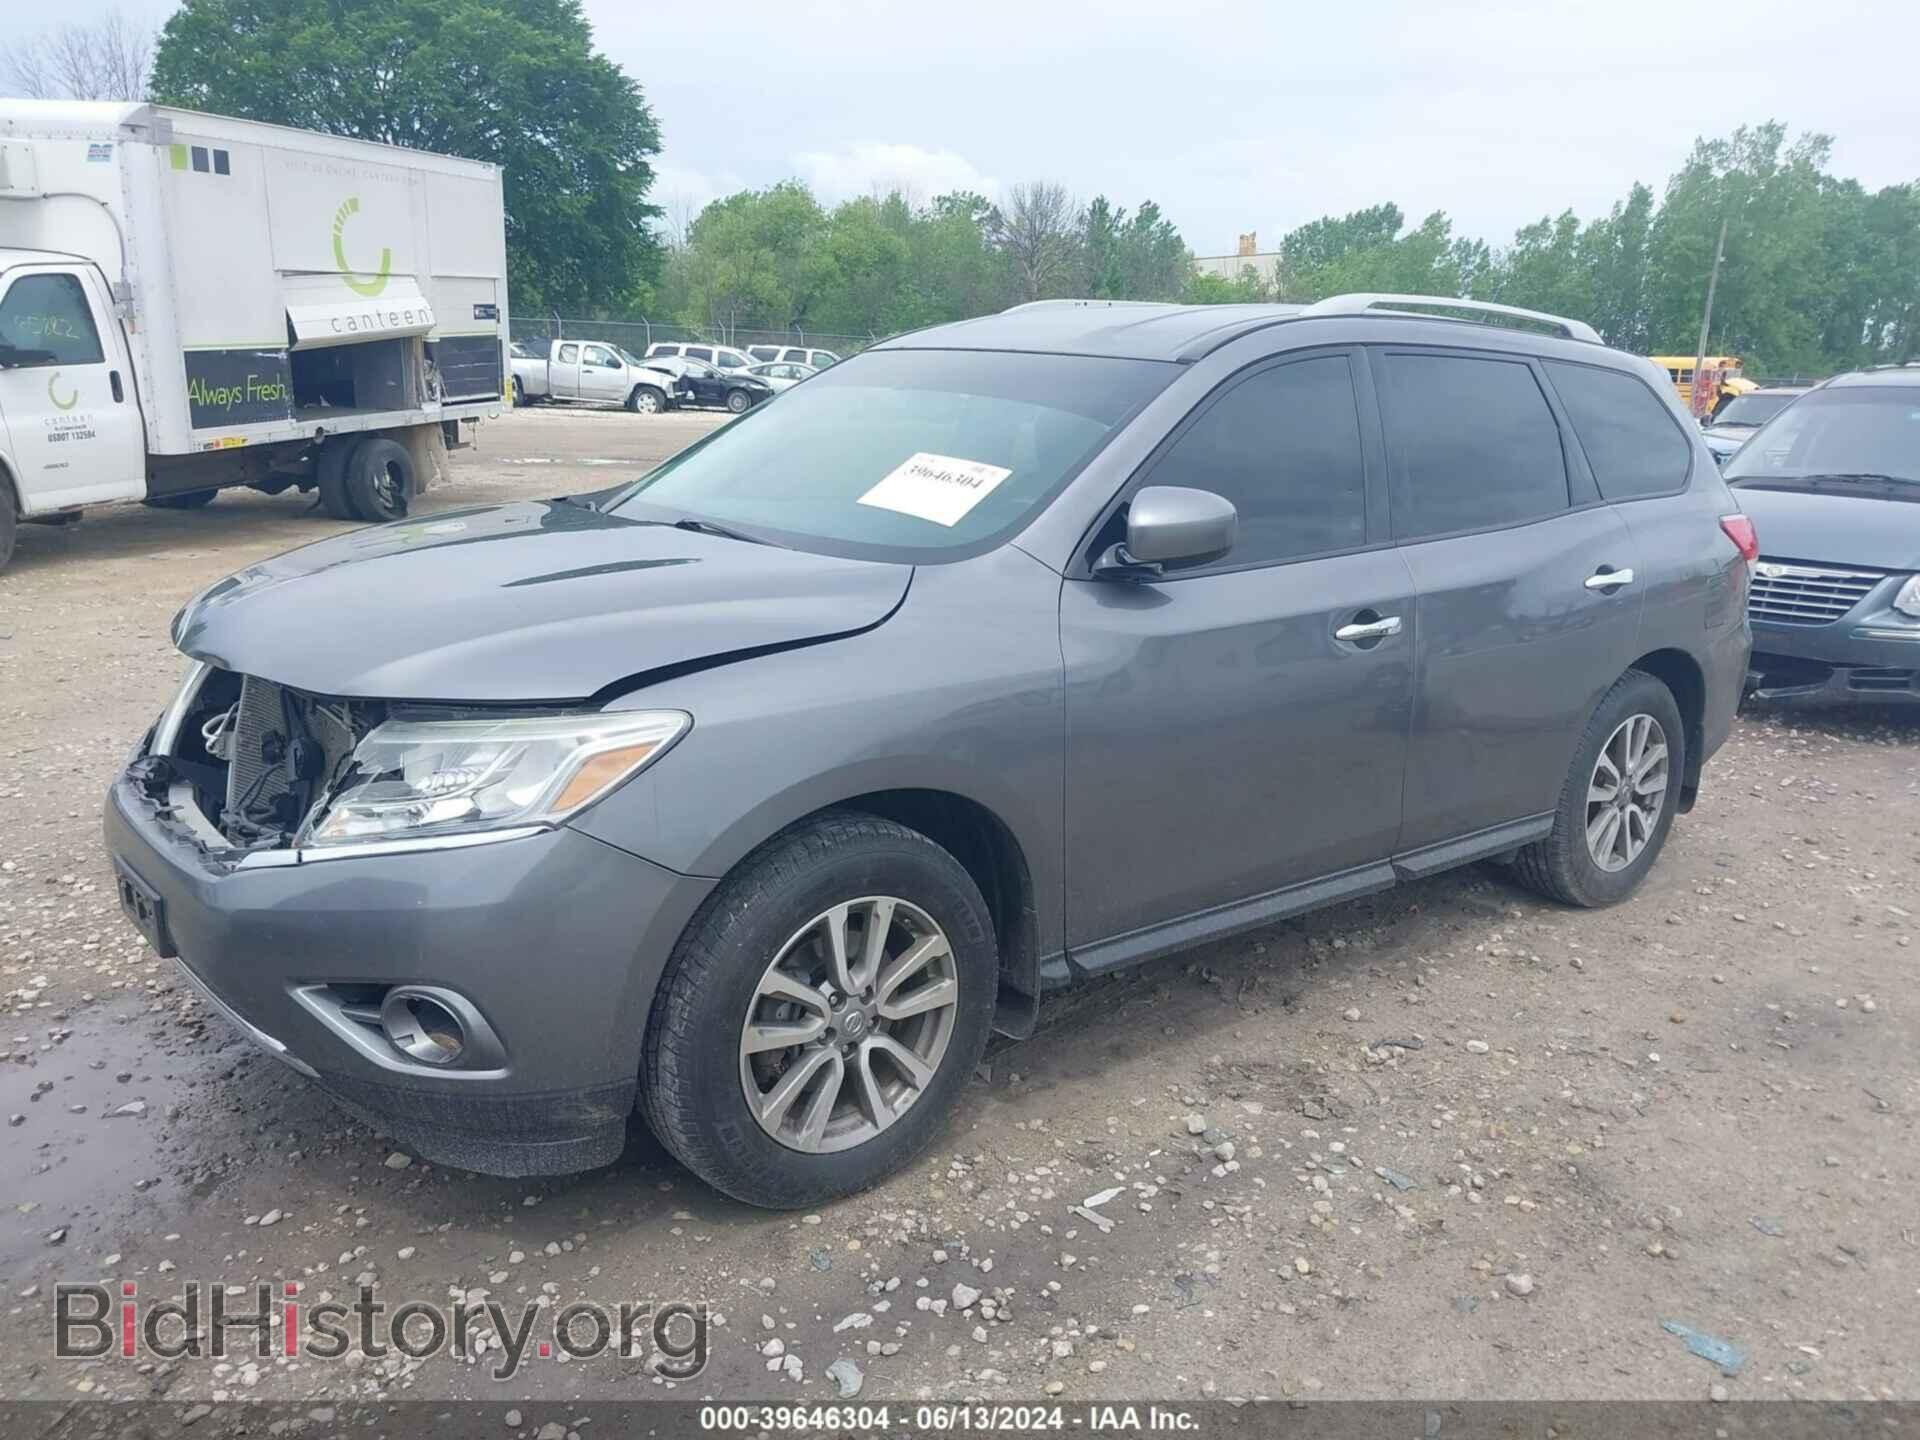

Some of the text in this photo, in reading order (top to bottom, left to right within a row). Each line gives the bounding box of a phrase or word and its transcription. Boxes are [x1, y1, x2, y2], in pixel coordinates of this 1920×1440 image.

[331, 308, 429, 333] canteen
[189, 378, 243, 412] Always
[48, 431, 70, 443] USDOT
